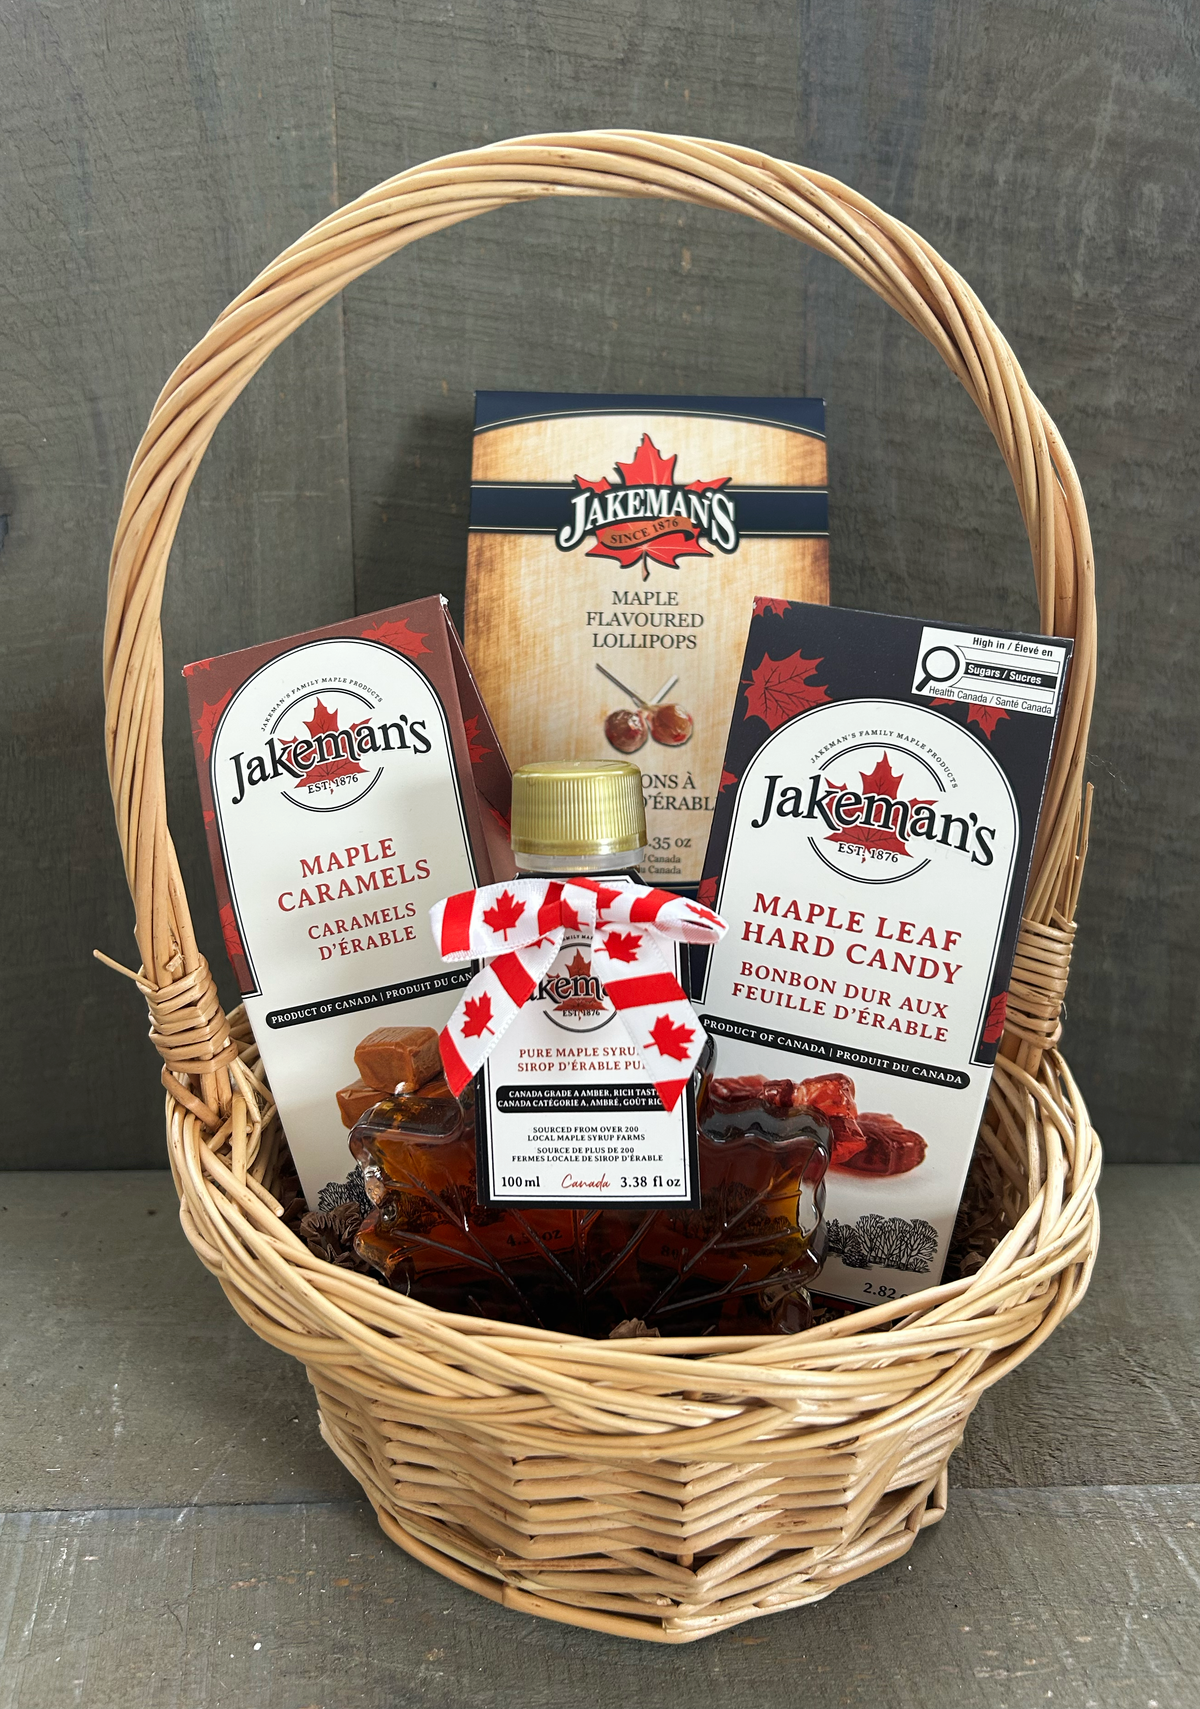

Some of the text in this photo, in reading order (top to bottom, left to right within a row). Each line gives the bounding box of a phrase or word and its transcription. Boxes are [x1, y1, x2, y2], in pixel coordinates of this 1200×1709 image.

[559, 488, 736, 550] JAKEMAN'S
[610, 519, 679, 544] SINCE 1876
[612, 591, 679, 606] MAPLE
[586, 611, 704, 628] FLAVOURED
[592, 633, 697, 649] LOLLIPOPS
[972, 637, 994, 649] High
[996, 640, 1005, 650] in
[1014, 642, 1039, 655] Élevé
[1041, 649, 1053, 657] en
[967, 664, 1001, 678] Sugars
[1009, 671, 1042, 685] Sucres
[261, 694, 291, 732] JAKEMAN'S
[291, 679, 319, 695] FAMILY
[349, 678, 383, 703] PRODUCTS
[929, 686, 955, 698] Health
[957, 690, 988, 703] Canada
[995, 696, 1019, 709] Santé
[1021, 701, 1052, 715] Canada
[229, 714, 432, 805] Jakeman's
[810, 729, 959, 789] JAKEMAN'S FAMILY MAPLE PRODUCTS
[334, 774, 359, 788] 1876
[640, 771, 696, 789] ONS À
[751, 774, 997, 866] Jakeman's
[648, 837, 692, 850] .35 oz
[300, 838, 397, 879] MAPLE
[648, 854, 681, 863] Canada
[870, 850, 899, 863] 1876
[648, 865, 681, 874] Canada
[278, 859, 431, 912] CARAMELS
[308, 902, 416, 940] CARAMELS
[753, 892, 962, 952] MAPLE LEAF
[318, 926, 417, 961] D'ÉRABLE
[741, 921, 963, 985] HARD CANDY
[272, 1008, 318, 1024] PRODUCT
[320, 1003, 333, 1014] OF
[335, 994, 378, 1011] CANADA
[386, 982, 431, 999] PRODUIT
[434, 977, 449, 989] DU
[451, 972, 473, 984] CAN
[740, 961, 949, 1020] BONBON DUR AUX
[731, 982, 949, 1042] FEUILLE D'ÉRABLE
[519, 1046, 639, 1058] PURE MAPLE SYRU
[703, 1019, 758, 1038] PRODUCT
[760, 1031, 775, 1042] OF
[777, 1036, 827, 1055] CANADA
[836, 1050, 890, 1069] PRODUIT
[892, 1061, 910, 1073] DU
[912, 1066, 963, 1085] CANADA
[517, 1062, 555, 1072] SIROP
[558, 1060, 621, 1071] D'ÉRABLE
[509, 1090, 542, 1098] CANADA
[544, 1090, 572, 1098] GRADE
[580, 1089, 612, 1098] AMBER,
[532, 1098, 579, 1107] CATÉGORIE
[579, 1099, 589, 1107] A,
[590, 1098, 622, 1107] AMBRÉ,
[623, 1097, 647, 1106] GOÛT
[648, 1098, 663, 1106] RIC
[561, 1173, 611, 1191] Canada
[620, 1176, 681, 1188] 3.38 fl oz
[863, 1282, 896, 1299] 2.82
